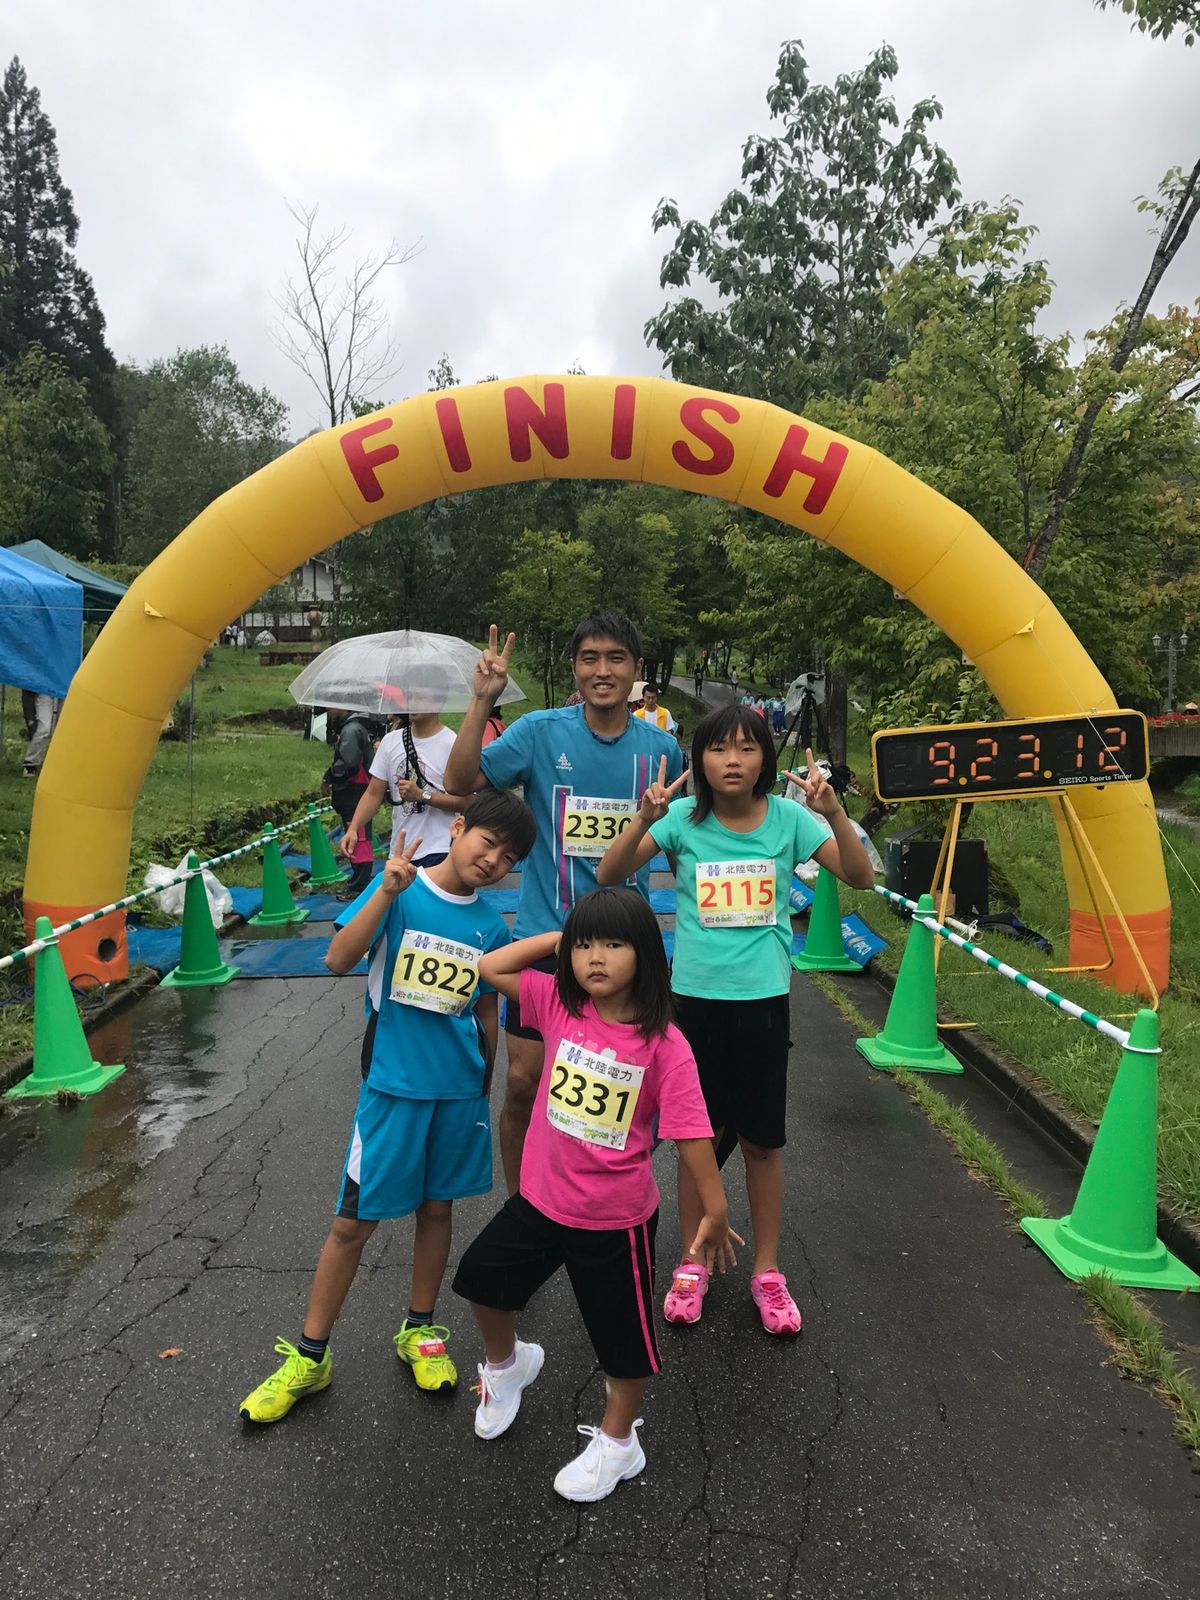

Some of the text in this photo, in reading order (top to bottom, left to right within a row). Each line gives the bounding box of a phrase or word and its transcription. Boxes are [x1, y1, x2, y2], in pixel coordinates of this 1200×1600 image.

[340, 382, 849, 515] FINISH
[1058, 776, 1088, 784] SEIKO
[592, 801, 630, 812] 北陸電力
[725, 864, 768, 874] 北陸電力
[700, 879, 774, 908] 2115
[433, 941, 475, 962] 北陸電力
[402, 952, 476, 998] 1822
[583, 1056, 633, 1082] 北陸電力
[549, 1065, 631, 1123] 2331
